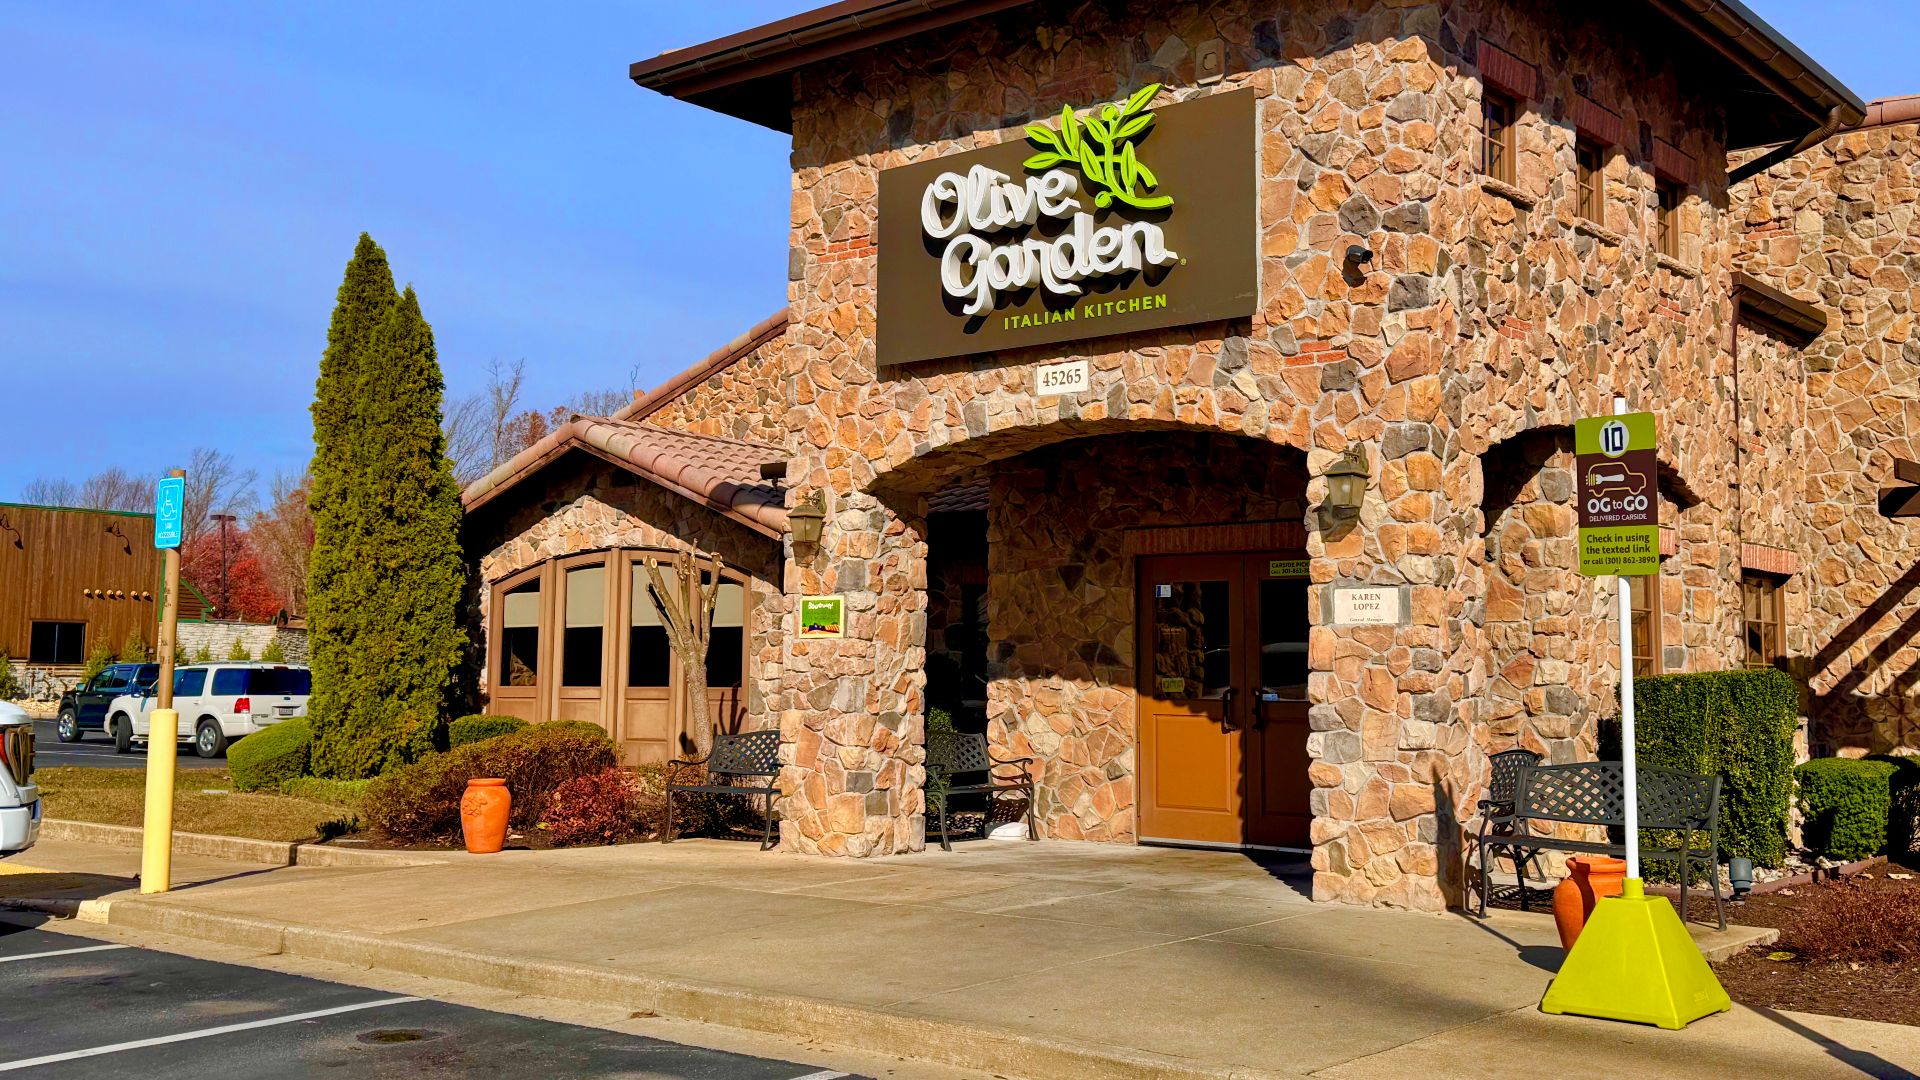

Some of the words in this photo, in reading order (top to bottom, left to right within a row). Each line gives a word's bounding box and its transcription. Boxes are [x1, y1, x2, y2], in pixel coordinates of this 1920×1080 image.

[920, 164, 1081, 239] Olive
[941, 211, 1179, 316] Garden
[1004, 306, 1076, 330] ITALIAN
[1084, 293, 1168, 318] KITCHEN
[1042, 367, 1082, 386] 45265
[1604, 426, 1623, 453] 10
[1587, 497, 1611, 514] OG
[1612, 500, 1623, 510] to
[1623, 495, 1648, 512] GO
[1589, 514, 1620, 523] DELIVERED
[1621, 513, 1648, 521] CARSIDE
[1586, 534, 1612, 544] Check
[1614, 533, 1623, 543] in
[1625, 532, 1650, 544] using
[1586, 545, 1601, 555] the
[1602, 544, 1630, 554] texted
[1632, 543, 1651, 553] link
[1605, 556, 1621, 565] (301)
[1622, 556, 1656, 564] 862-3890
[1351, 593, 1381, 601] KAREN
